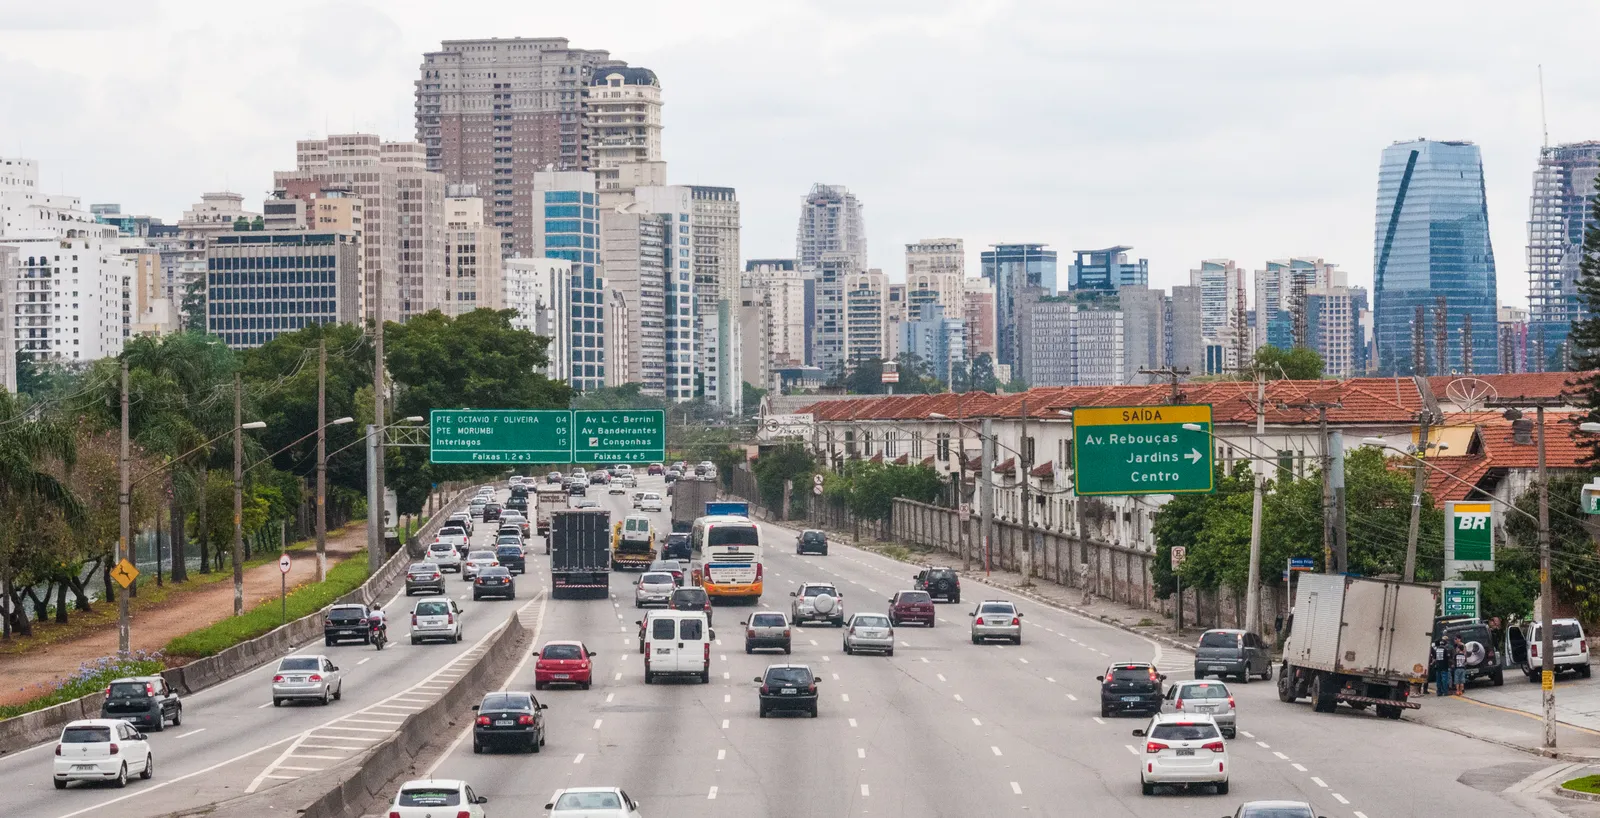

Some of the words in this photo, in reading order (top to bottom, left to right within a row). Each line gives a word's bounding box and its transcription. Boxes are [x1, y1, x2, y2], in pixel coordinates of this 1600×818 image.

[457, 416, 490, 424] OCTAVIO
[503, 416, 540, 424] OLIVEIRA
[555, 416, 567, 424] 04
[1122, 408, 1163, 422] SAÍDA
[457, 427, 494, 435] MORUMBI
[556, 427, 567, 435] 05
[581, 427, 595, 435] Av.
[597, 427, 657, 435] Bandeirantes
[436, 438, 482, 447] Interlagos
[558, 438, 567, 446] 15
[603, 438, 652, 447] Congonhas
[1084, 434, 1105, 445] Av.
[1109, 433, 1179, 446] Rebouças
[1126, 452, 1179, 464] Jardins
[1131, 471, 1179, 483] Centro
[1458, 516, 1487, 530] BR
